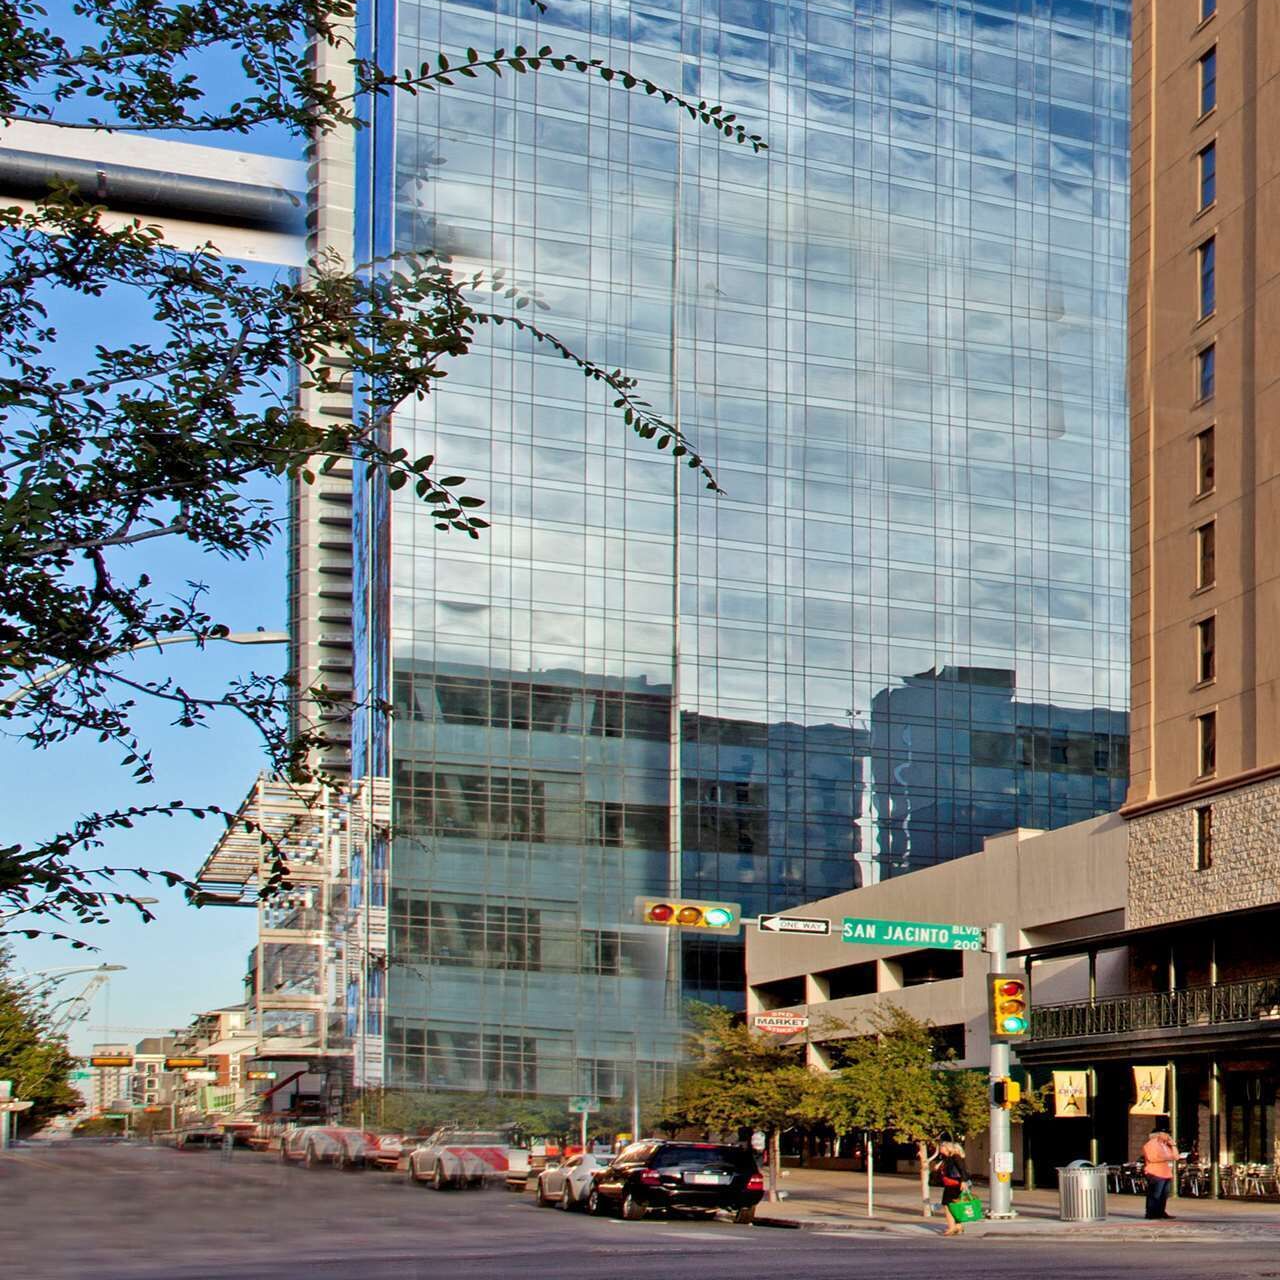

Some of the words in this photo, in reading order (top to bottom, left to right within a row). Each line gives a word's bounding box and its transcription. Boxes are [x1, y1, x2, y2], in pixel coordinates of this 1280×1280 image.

[780, 921, 800, 929] ONE
[803, 922, 822, 930] WAY
[952, 925, 980, 935] BLVD
[844, 922, 876, 938] SAN
[883, 925, 949, 944] JACINTO
[953, 939, 979, 951] 200
[757, 1018, 806, 1026] MARKET
